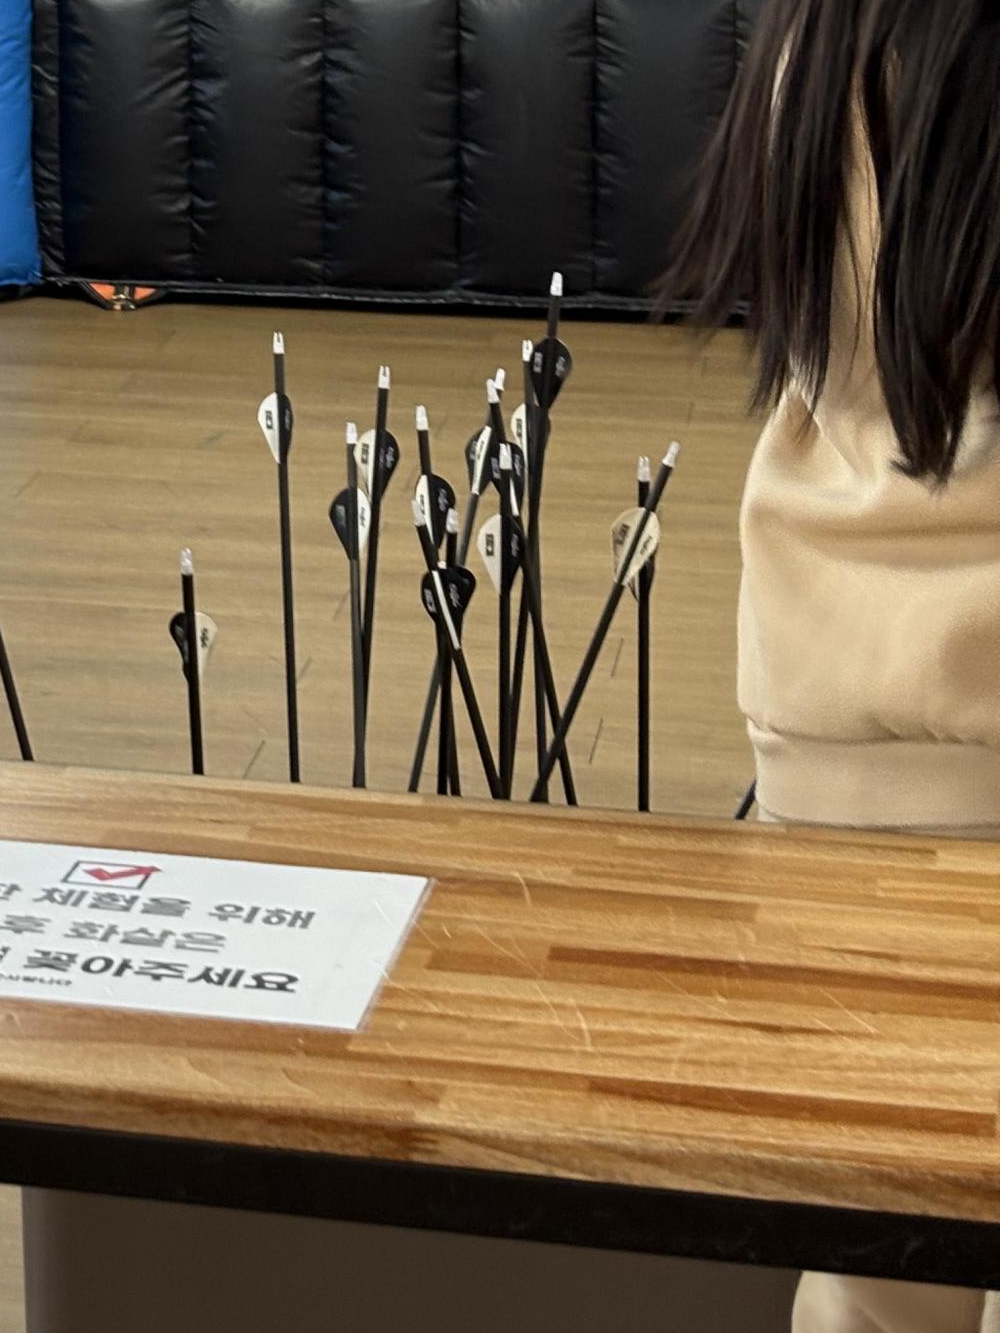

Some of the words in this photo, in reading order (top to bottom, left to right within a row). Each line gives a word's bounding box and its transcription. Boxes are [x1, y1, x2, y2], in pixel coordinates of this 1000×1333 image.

[32, 887, 191, 917] 체험을
[208, 902, 316, 929] 위해
[63, 920, 226, 953] 화살은
